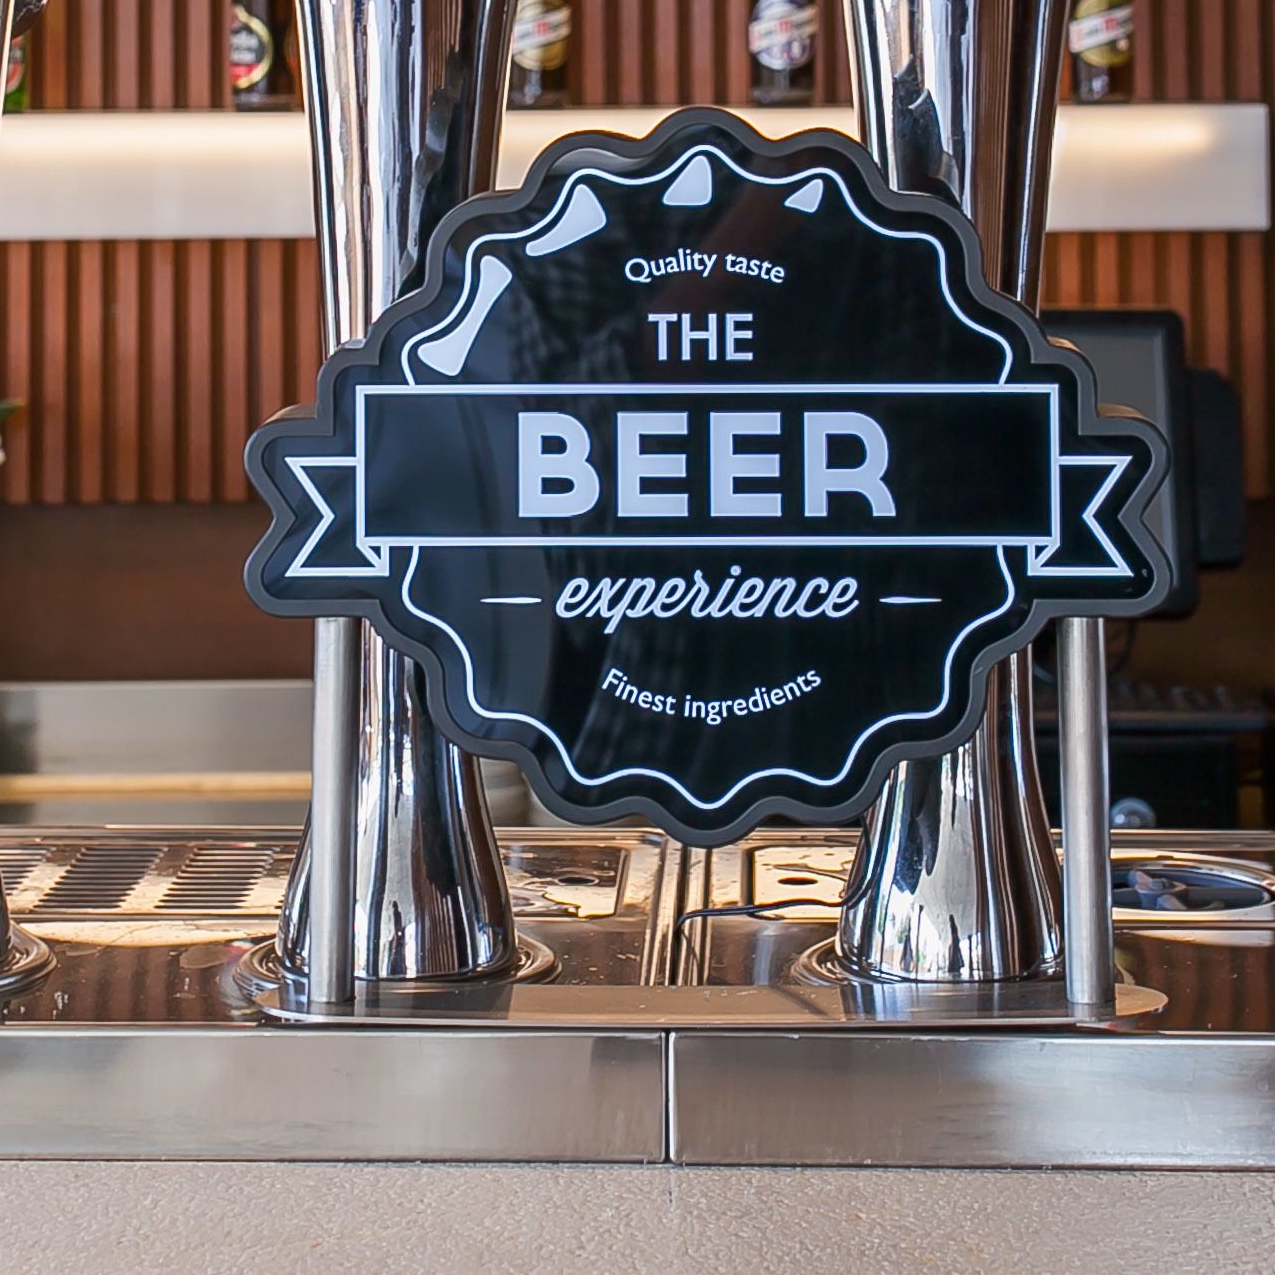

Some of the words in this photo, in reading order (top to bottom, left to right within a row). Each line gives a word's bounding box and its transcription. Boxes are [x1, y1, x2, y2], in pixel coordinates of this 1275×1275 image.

[624, 247, 718, 284] Quality
[724, 253, 786, 284] taste
[646, 312, 754, 362] THE
[517, 410, 897, 518] BEER
[554, 564, 860, 635] experience
[600, 667, 677, 716] Finest
[683, 669, 822, 726] ingredients
